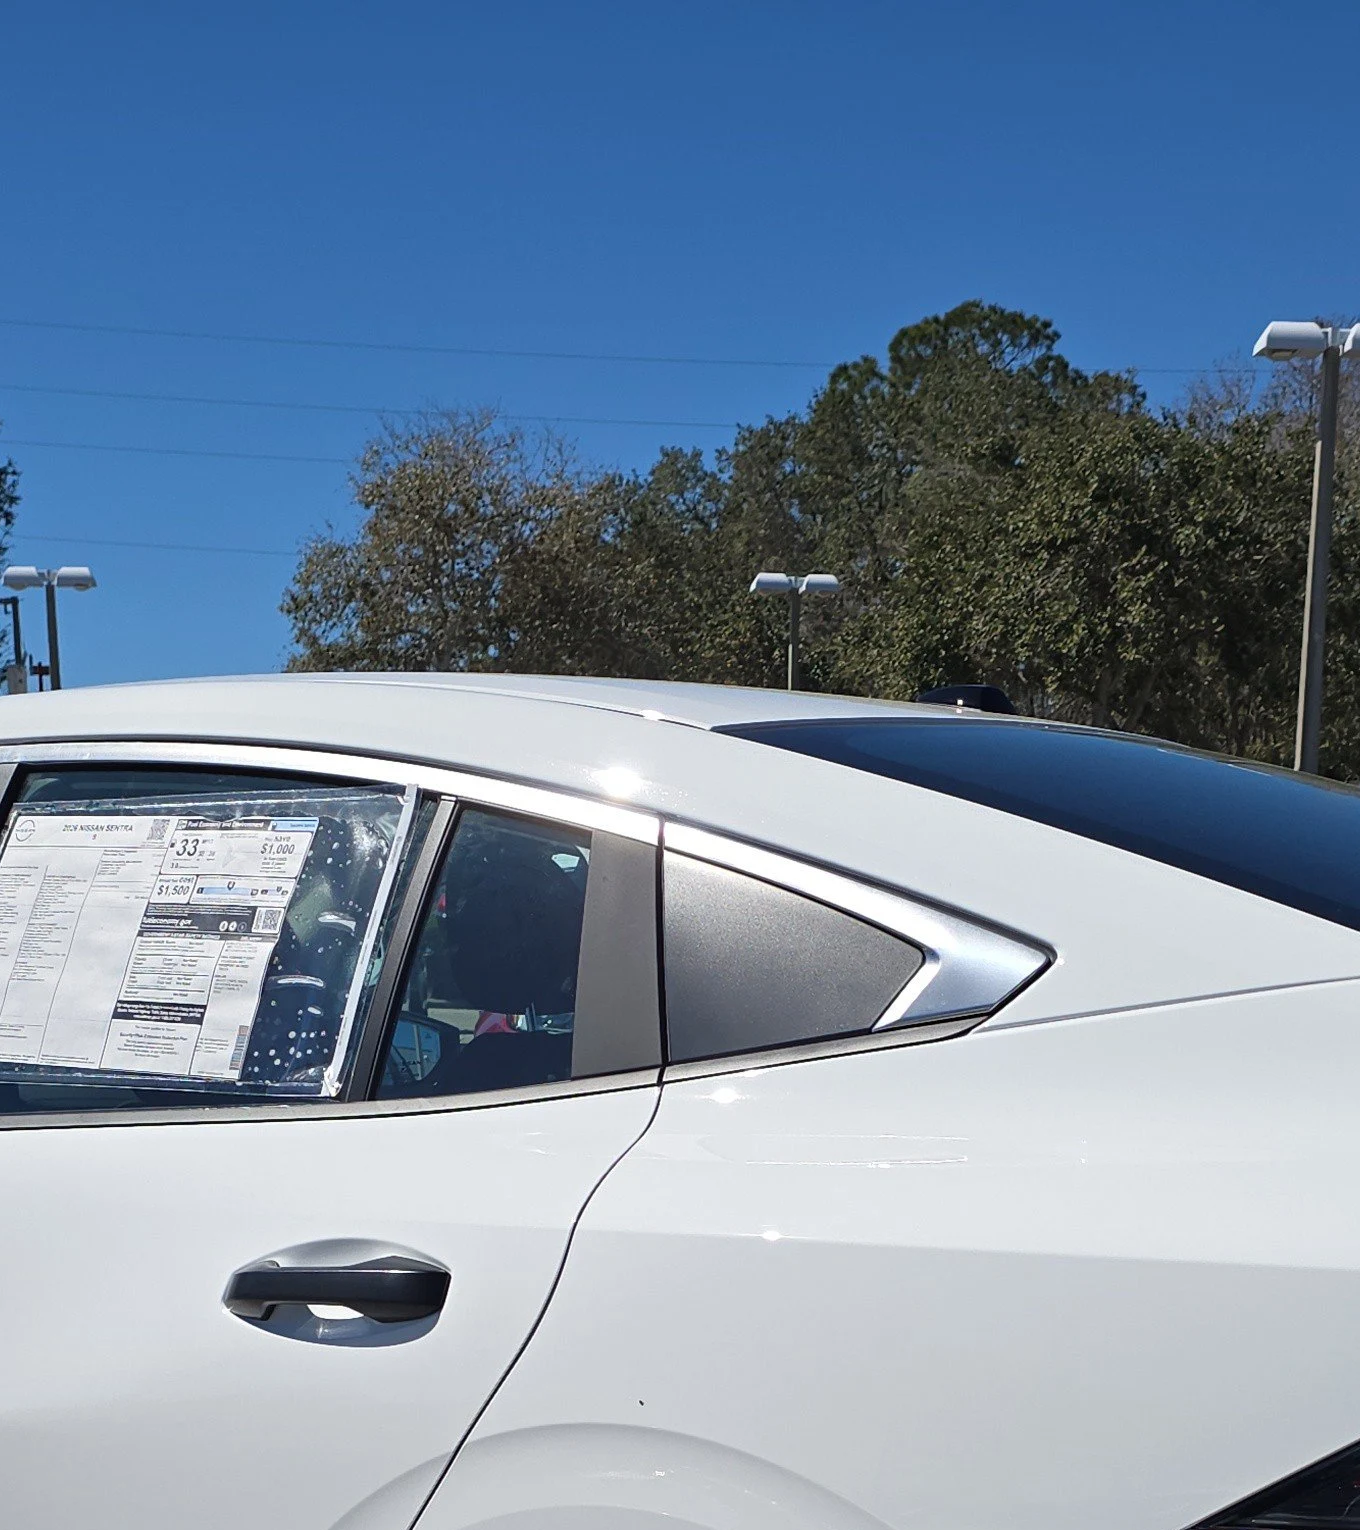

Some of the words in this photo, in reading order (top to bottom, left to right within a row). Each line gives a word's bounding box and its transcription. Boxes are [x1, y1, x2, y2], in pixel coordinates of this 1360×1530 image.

[79, 824, 105, 832] NISSAN
[105, 824, 133, 832] SENTRA
[176, 838, 200, 857] 33
[260, 843, 295, 855] $1,000
[157, 884, 190, 897] $1,500
